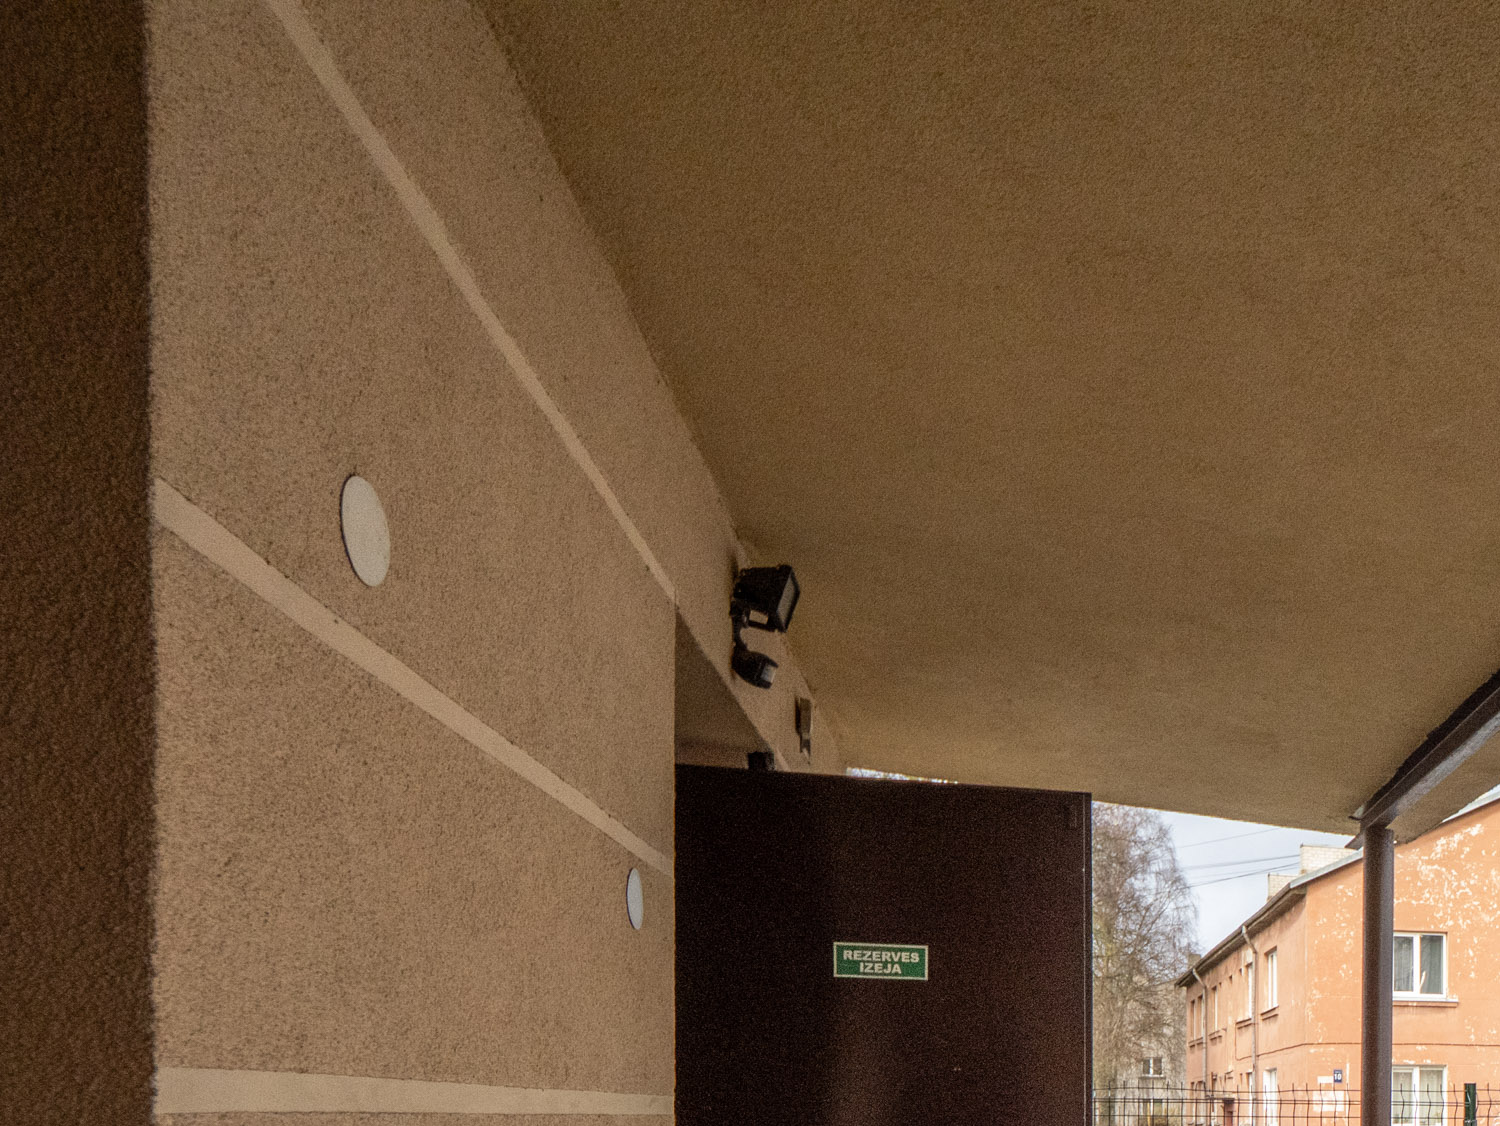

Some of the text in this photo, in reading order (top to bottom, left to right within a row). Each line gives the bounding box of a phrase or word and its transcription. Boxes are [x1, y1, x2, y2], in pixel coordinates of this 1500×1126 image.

[843, 950, 919, 963] REZERVES
[860, 962, 901, 974] IZEJA
[1334, 1073, 1342, 1081] 10
